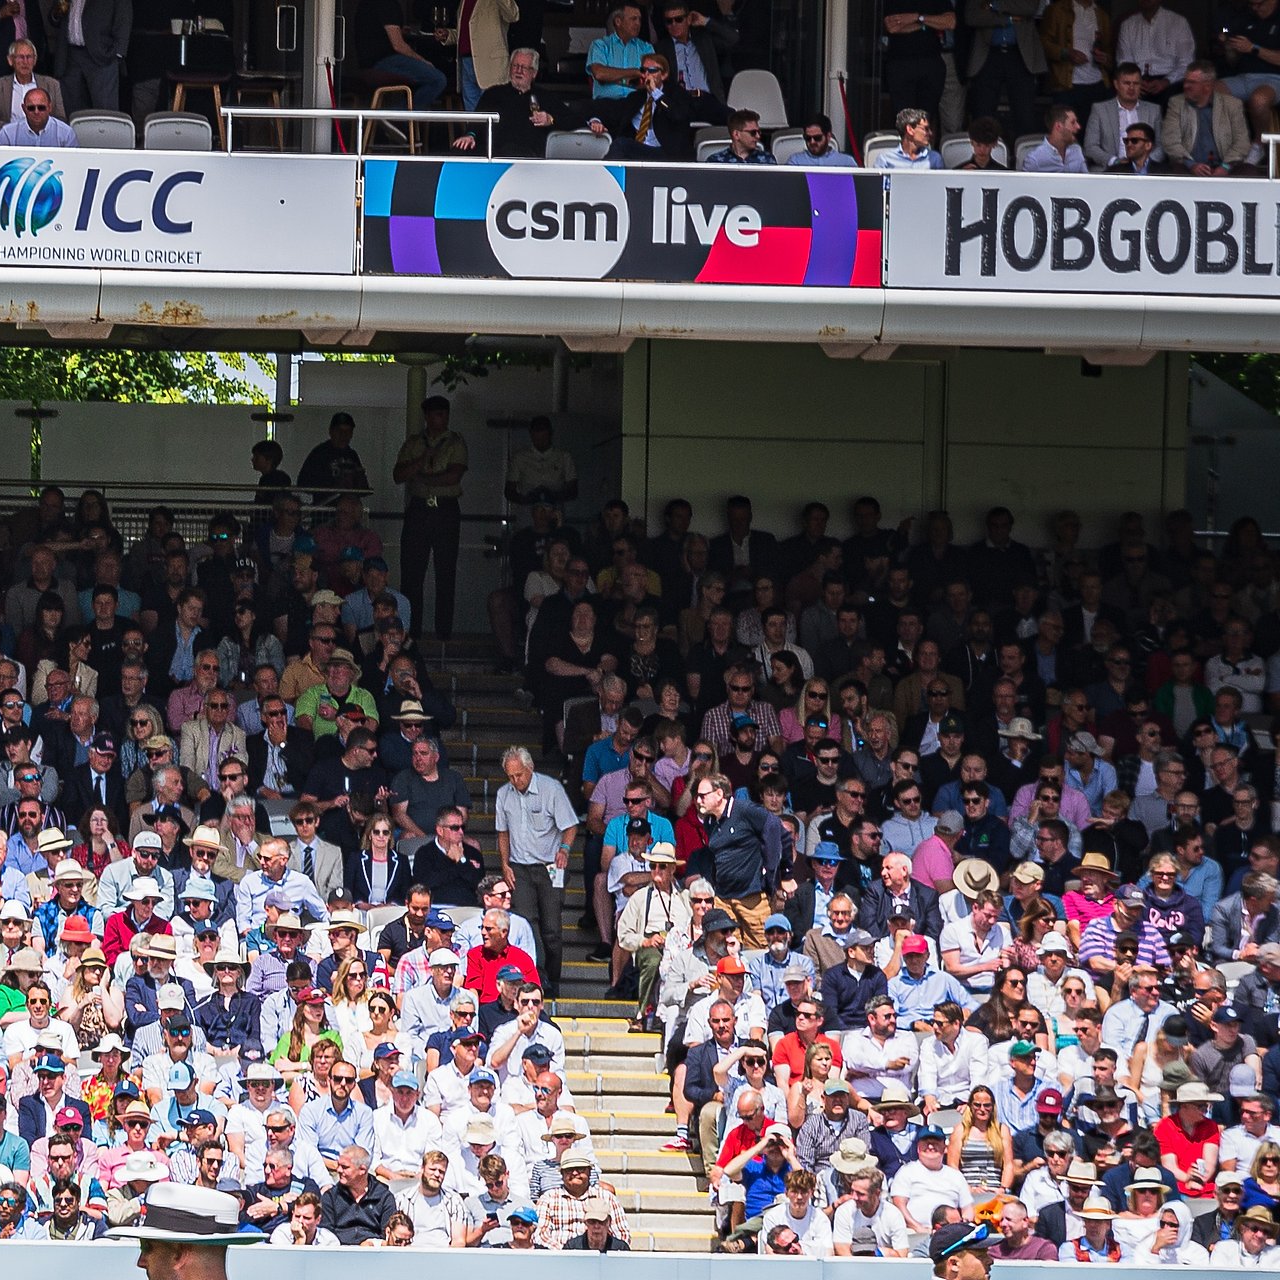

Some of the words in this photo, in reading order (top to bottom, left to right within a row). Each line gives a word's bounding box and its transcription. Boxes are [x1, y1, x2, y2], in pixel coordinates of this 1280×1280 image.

[74, 168, 205, 234] ICC
[495, 199, 619, 242] csm
[652, 186, 762, 248] live
[943, 187, 1280, 277] HOBGOBL
[90, 248, 140, 263] WORLD
[145, 250, 203, 265] CRICKET
